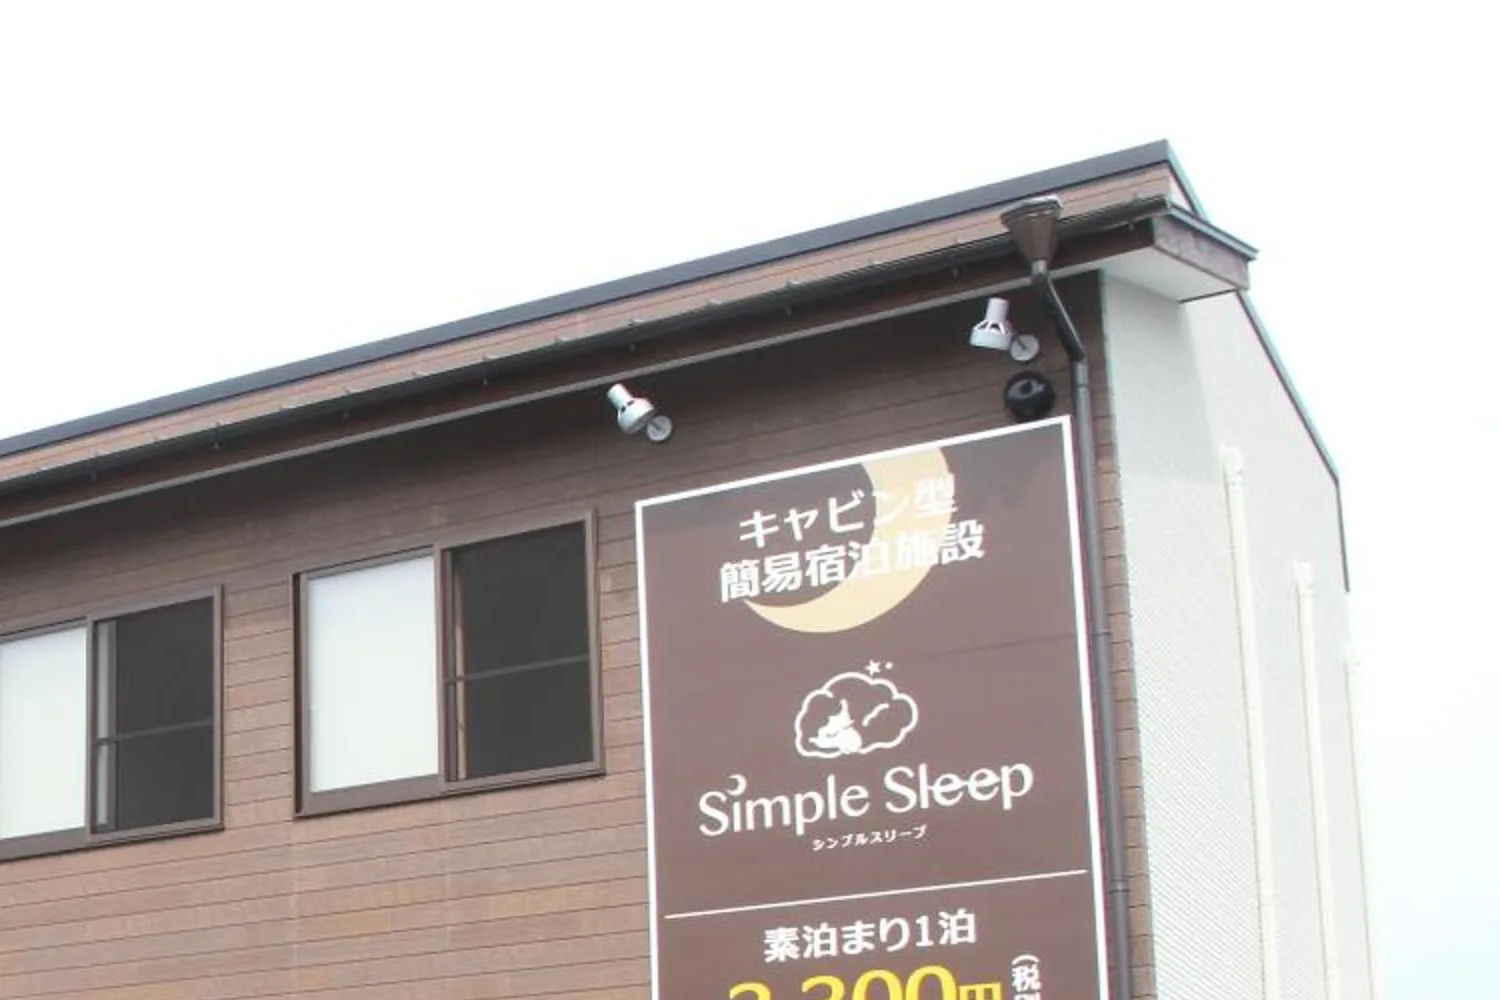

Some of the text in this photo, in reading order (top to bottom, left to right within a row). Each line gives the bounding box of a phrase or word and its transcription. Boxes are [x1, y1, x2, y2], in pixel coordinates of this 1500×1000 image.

[738, 472, 958, 548] キャビン型
[719, 518, 984, 603] 簡易宿泊施設
[698, 760, 1034, 836] Simple Sleep
[812, 823, 927, 852] シンプルスリープ
[763, 907, 977, 963] 素泊まり1泊
